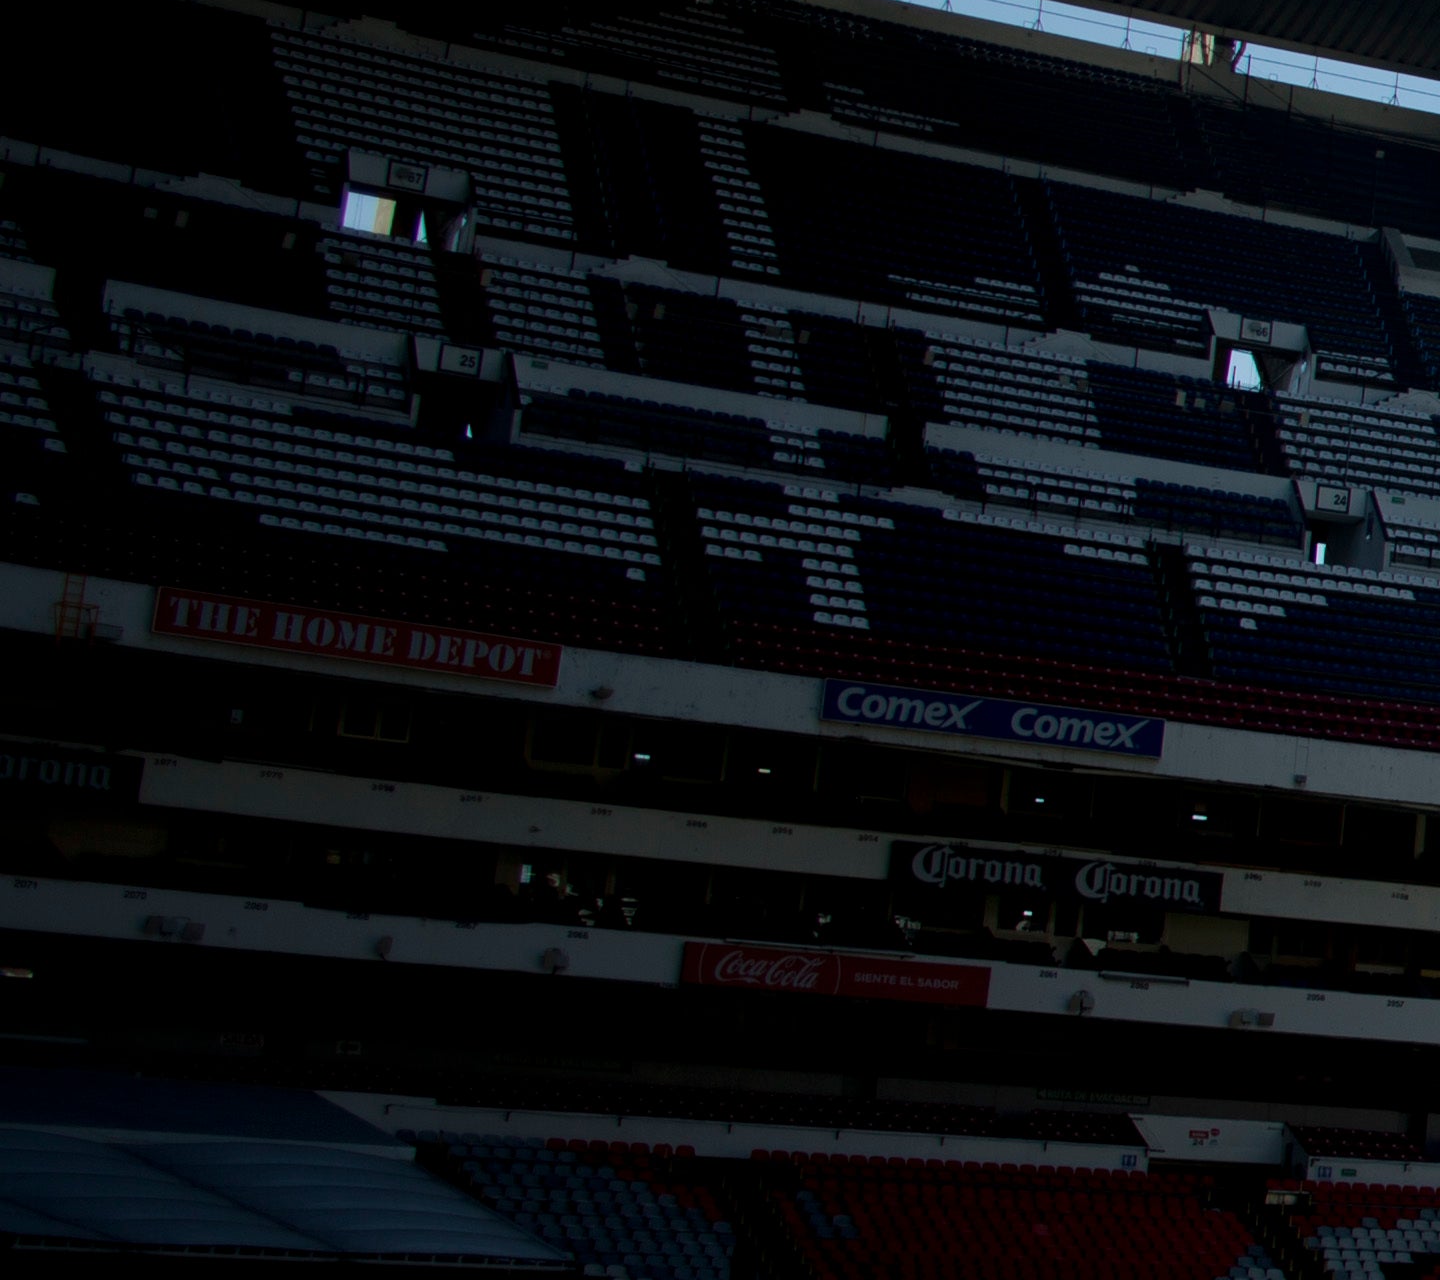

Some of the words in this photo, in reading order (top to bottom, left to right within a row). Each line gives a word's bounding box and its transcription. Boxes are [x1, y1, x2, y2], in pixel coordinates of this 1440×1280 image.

[460, 355, 476, 368] 25
[1334, 494, 1347, 507] 24
[168, 595, 263, 638] THE
[269, 609, 401, 659] HOME
[405, 629, 545, 679] DEPOT
[836, 686, 983, 730] Comex
[1010, 704, 1151, 751] Comex
[0, 750, 113, 792] orona
[14, 880, 38, 889] 2071
[911, 843, 1047, 891] Corona
[1073, 859, 1201, 906] Corona
[714, 950, 827, 990] Coca-Cola
[853, 970, 897, 986] SIENTE
[899, 975, 915, 986] EL
[917, 977, 960, 991] SABOR
[1387, 999, 1404, 1008] 2057
